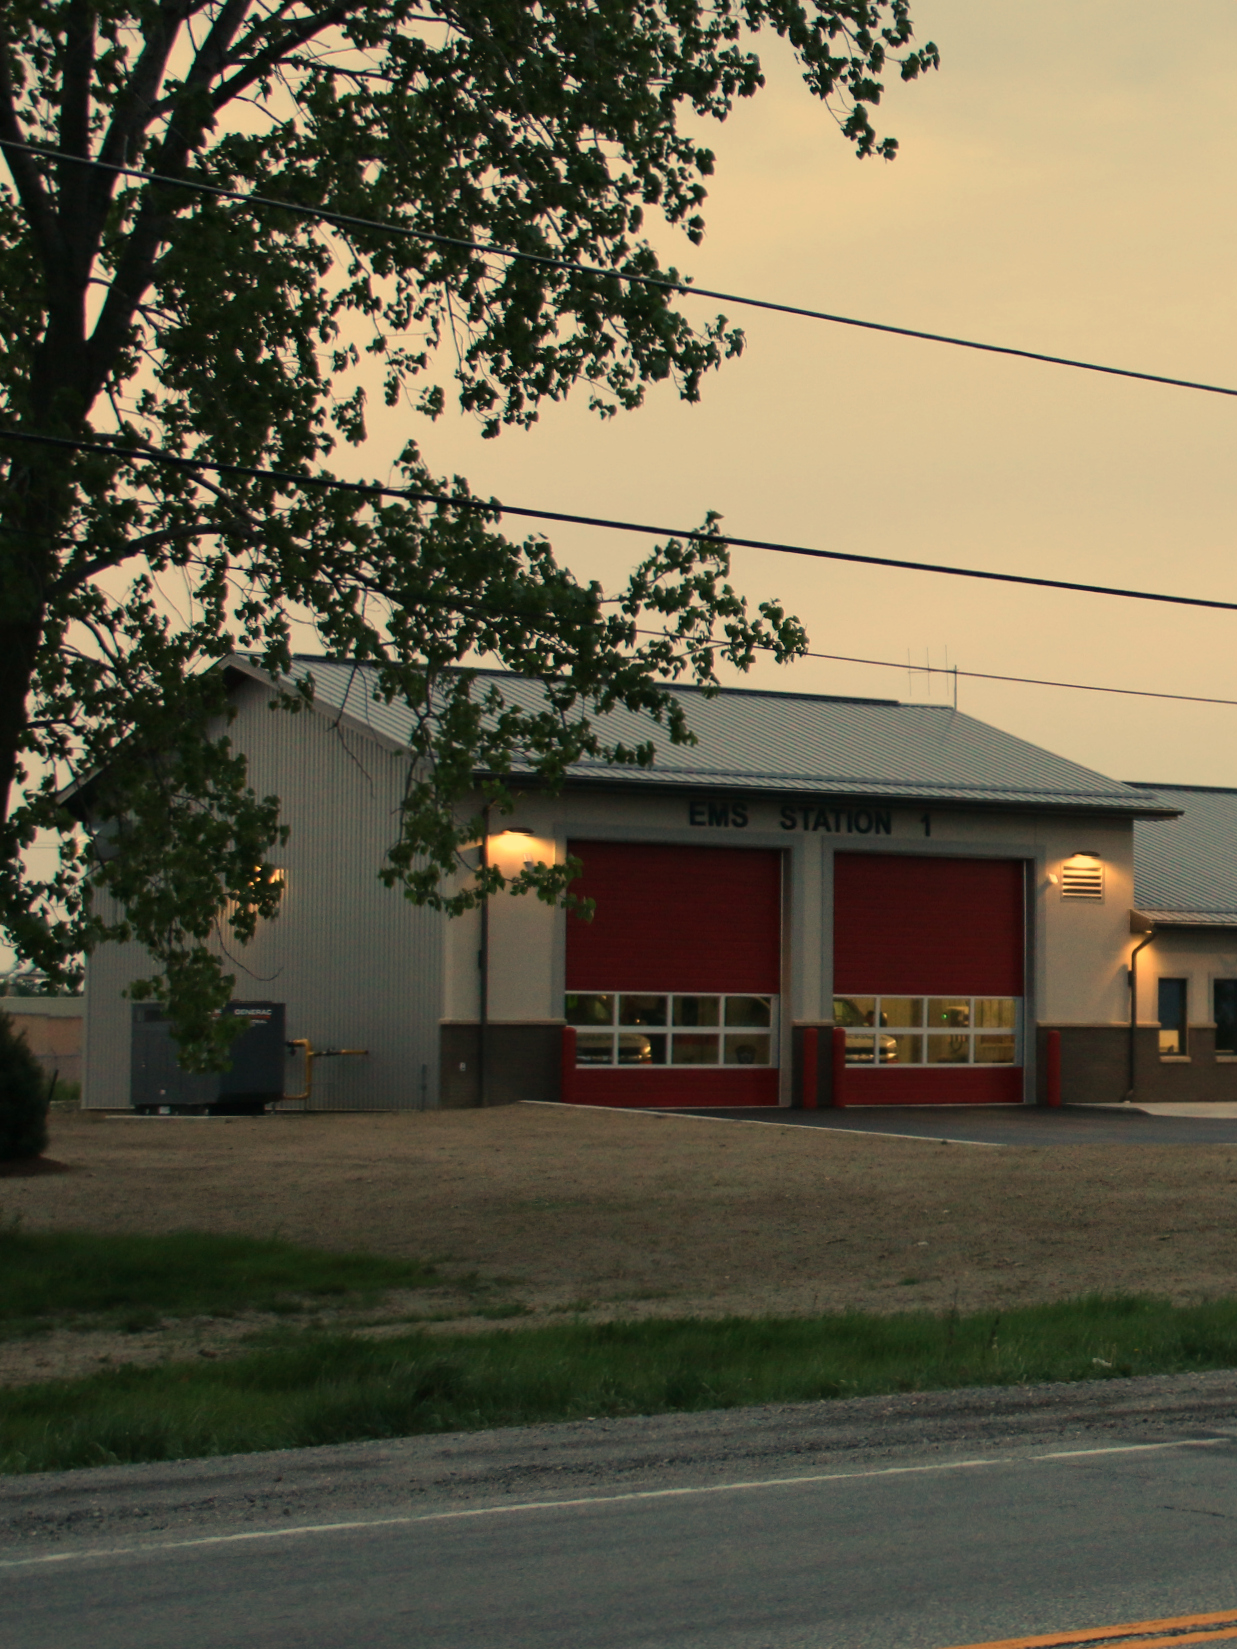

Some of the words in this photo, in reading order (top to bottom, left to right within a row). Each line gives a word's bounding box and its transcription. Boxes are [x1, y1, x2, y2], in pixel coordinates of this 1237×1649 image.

[689, 801, 749, 828] EMS
[780, 805, 892, 835] STATION
[920, 813, 932, 837] 1
